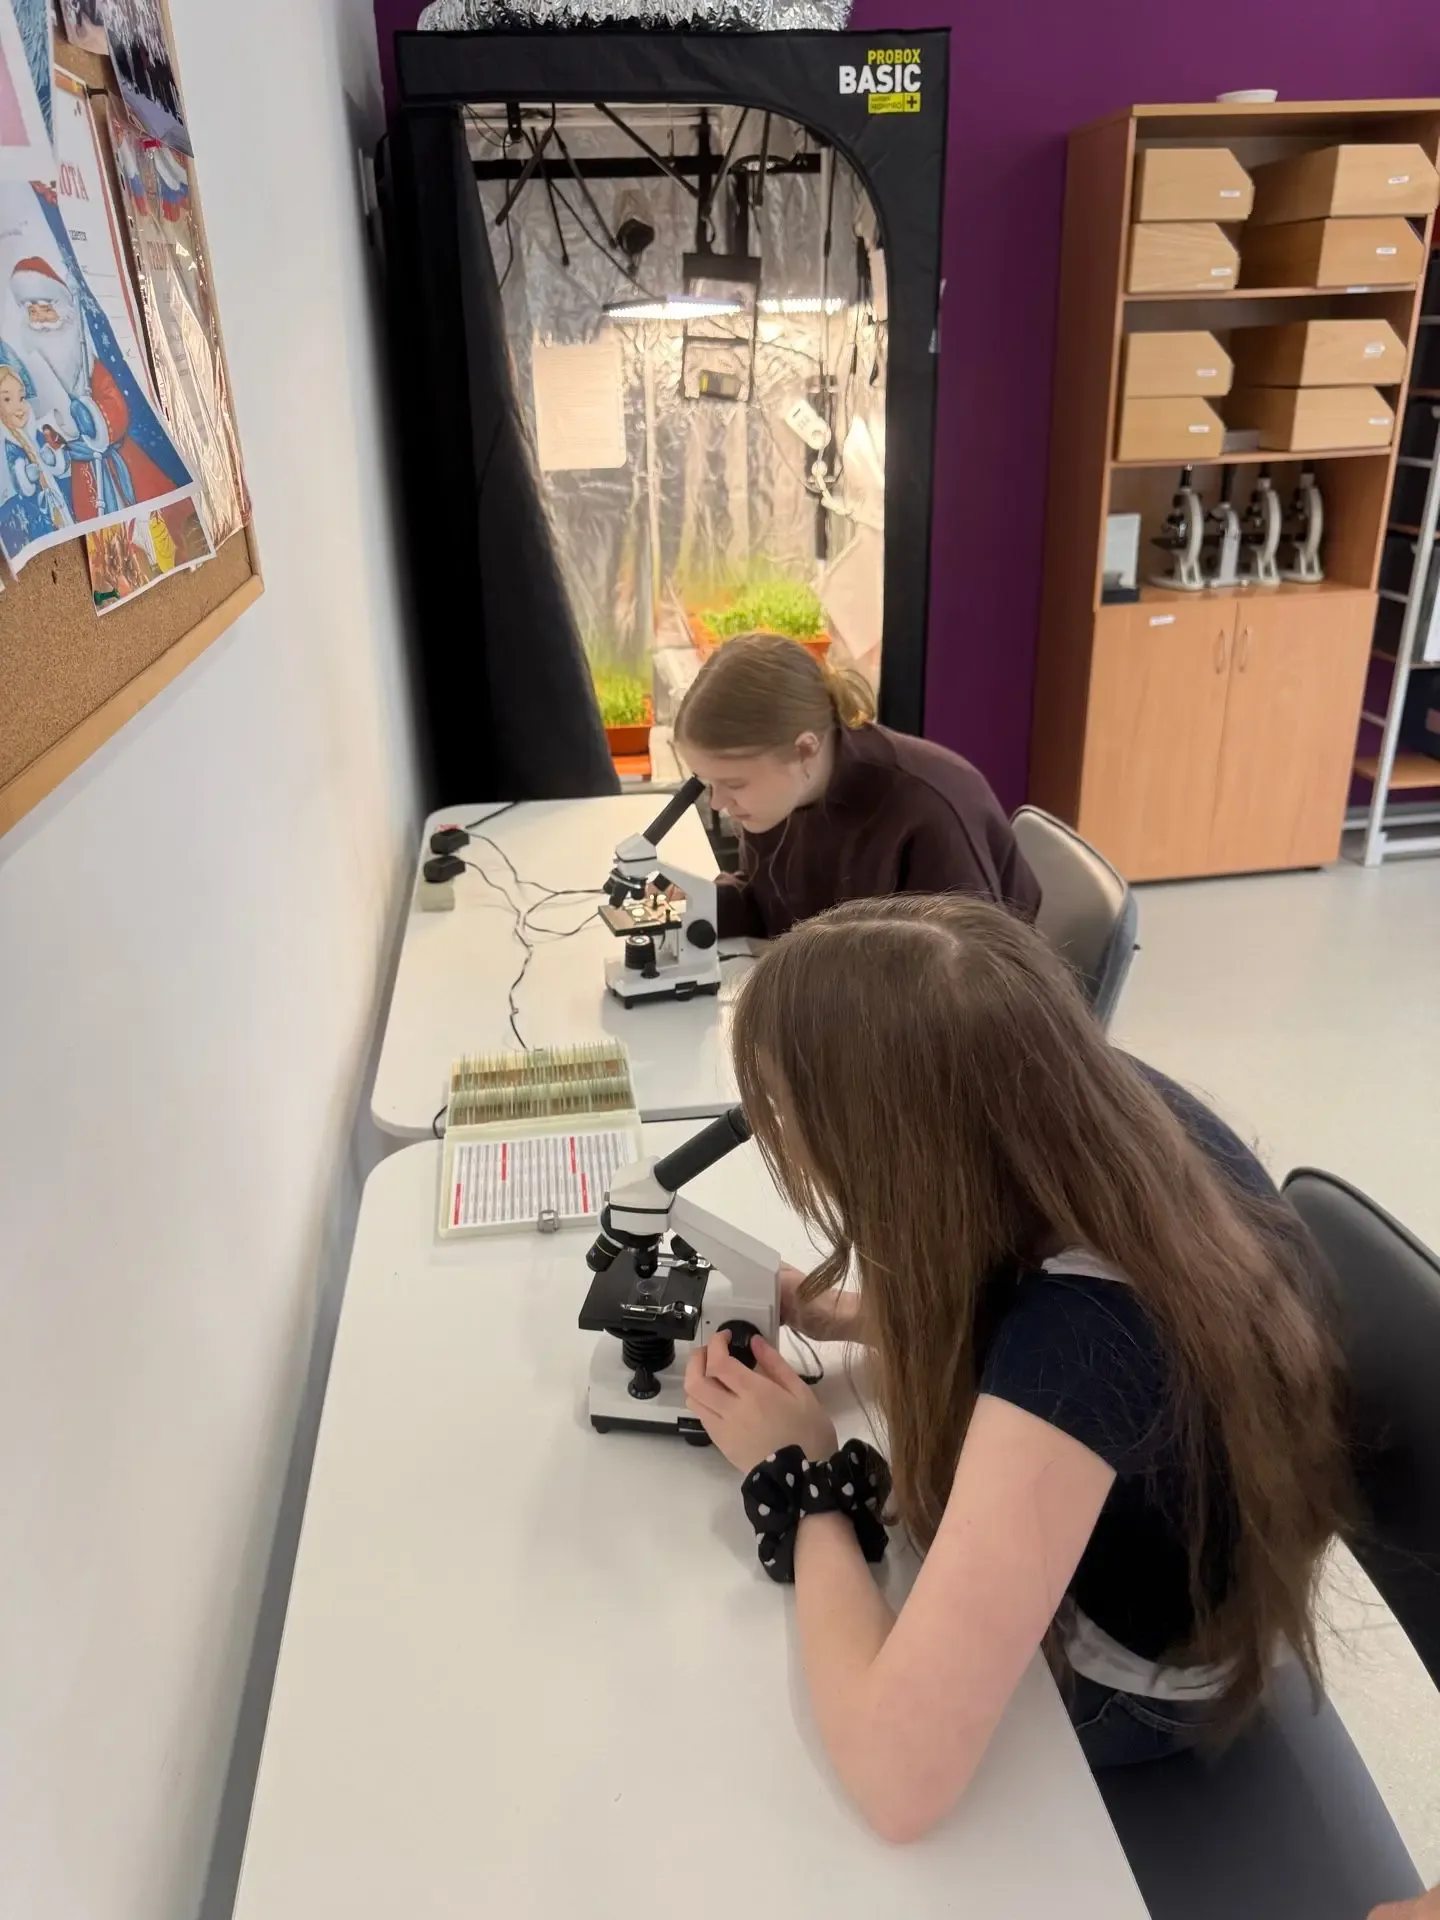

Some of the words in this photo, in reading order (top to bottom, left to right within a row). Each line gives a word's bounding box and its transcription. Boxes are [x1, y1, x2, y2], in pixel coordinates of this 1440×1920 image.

[867, 48, 921, 64] PROBOX
[839, 63, 921, 94] BASIC
[60, 163, 90, 202] ОТА
